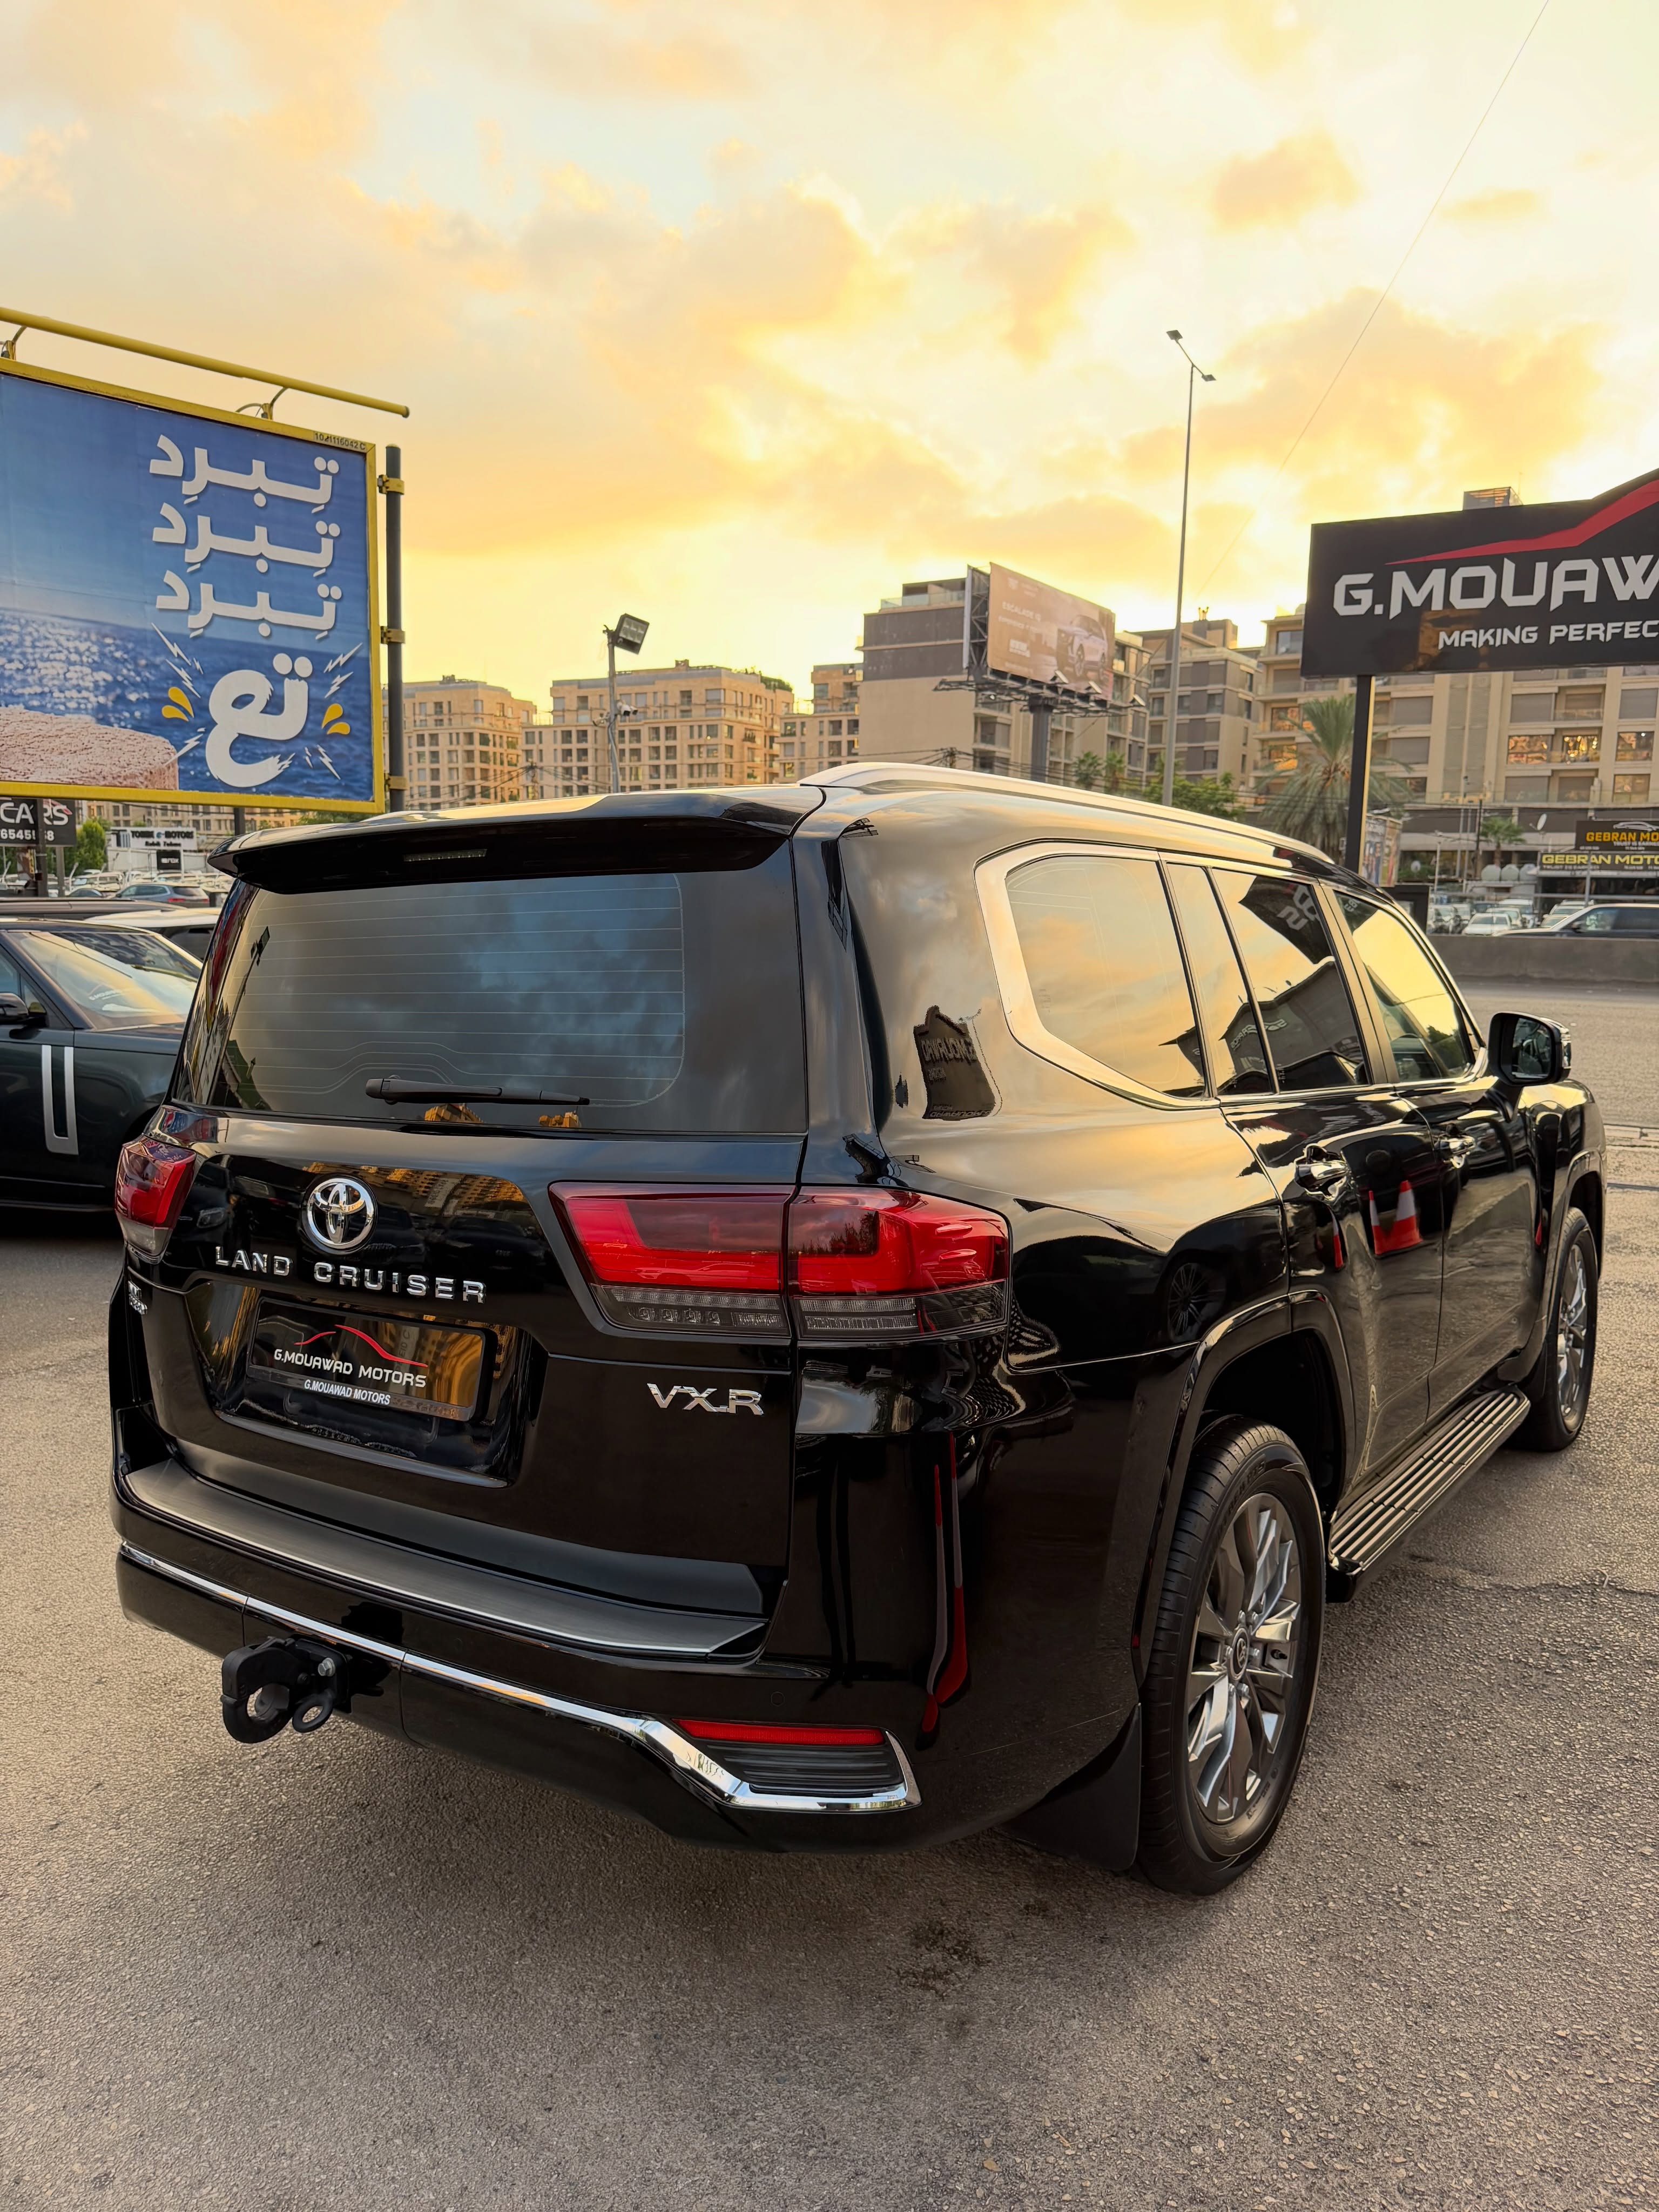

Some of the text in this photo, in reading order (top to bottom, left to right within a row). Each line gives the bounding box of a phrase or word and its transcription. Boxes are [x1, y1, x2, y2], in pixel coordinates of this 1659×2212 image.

[1333, 554, 1659, 620] G.MOUAW
[1439, 620, 1659, 650] MAKING PERFEC
[1586, 832, 1636, 842] GEBRAN
[1542, 854, 1611, 865] GEBRAN
[215, 1246, 485, 1304] LAND CRUISER
[273, 1349, 427, 1388] G.MOUAWAD MOTORS
[304, 1379, 391, 1405] G.MOUAWAD MOTORS
